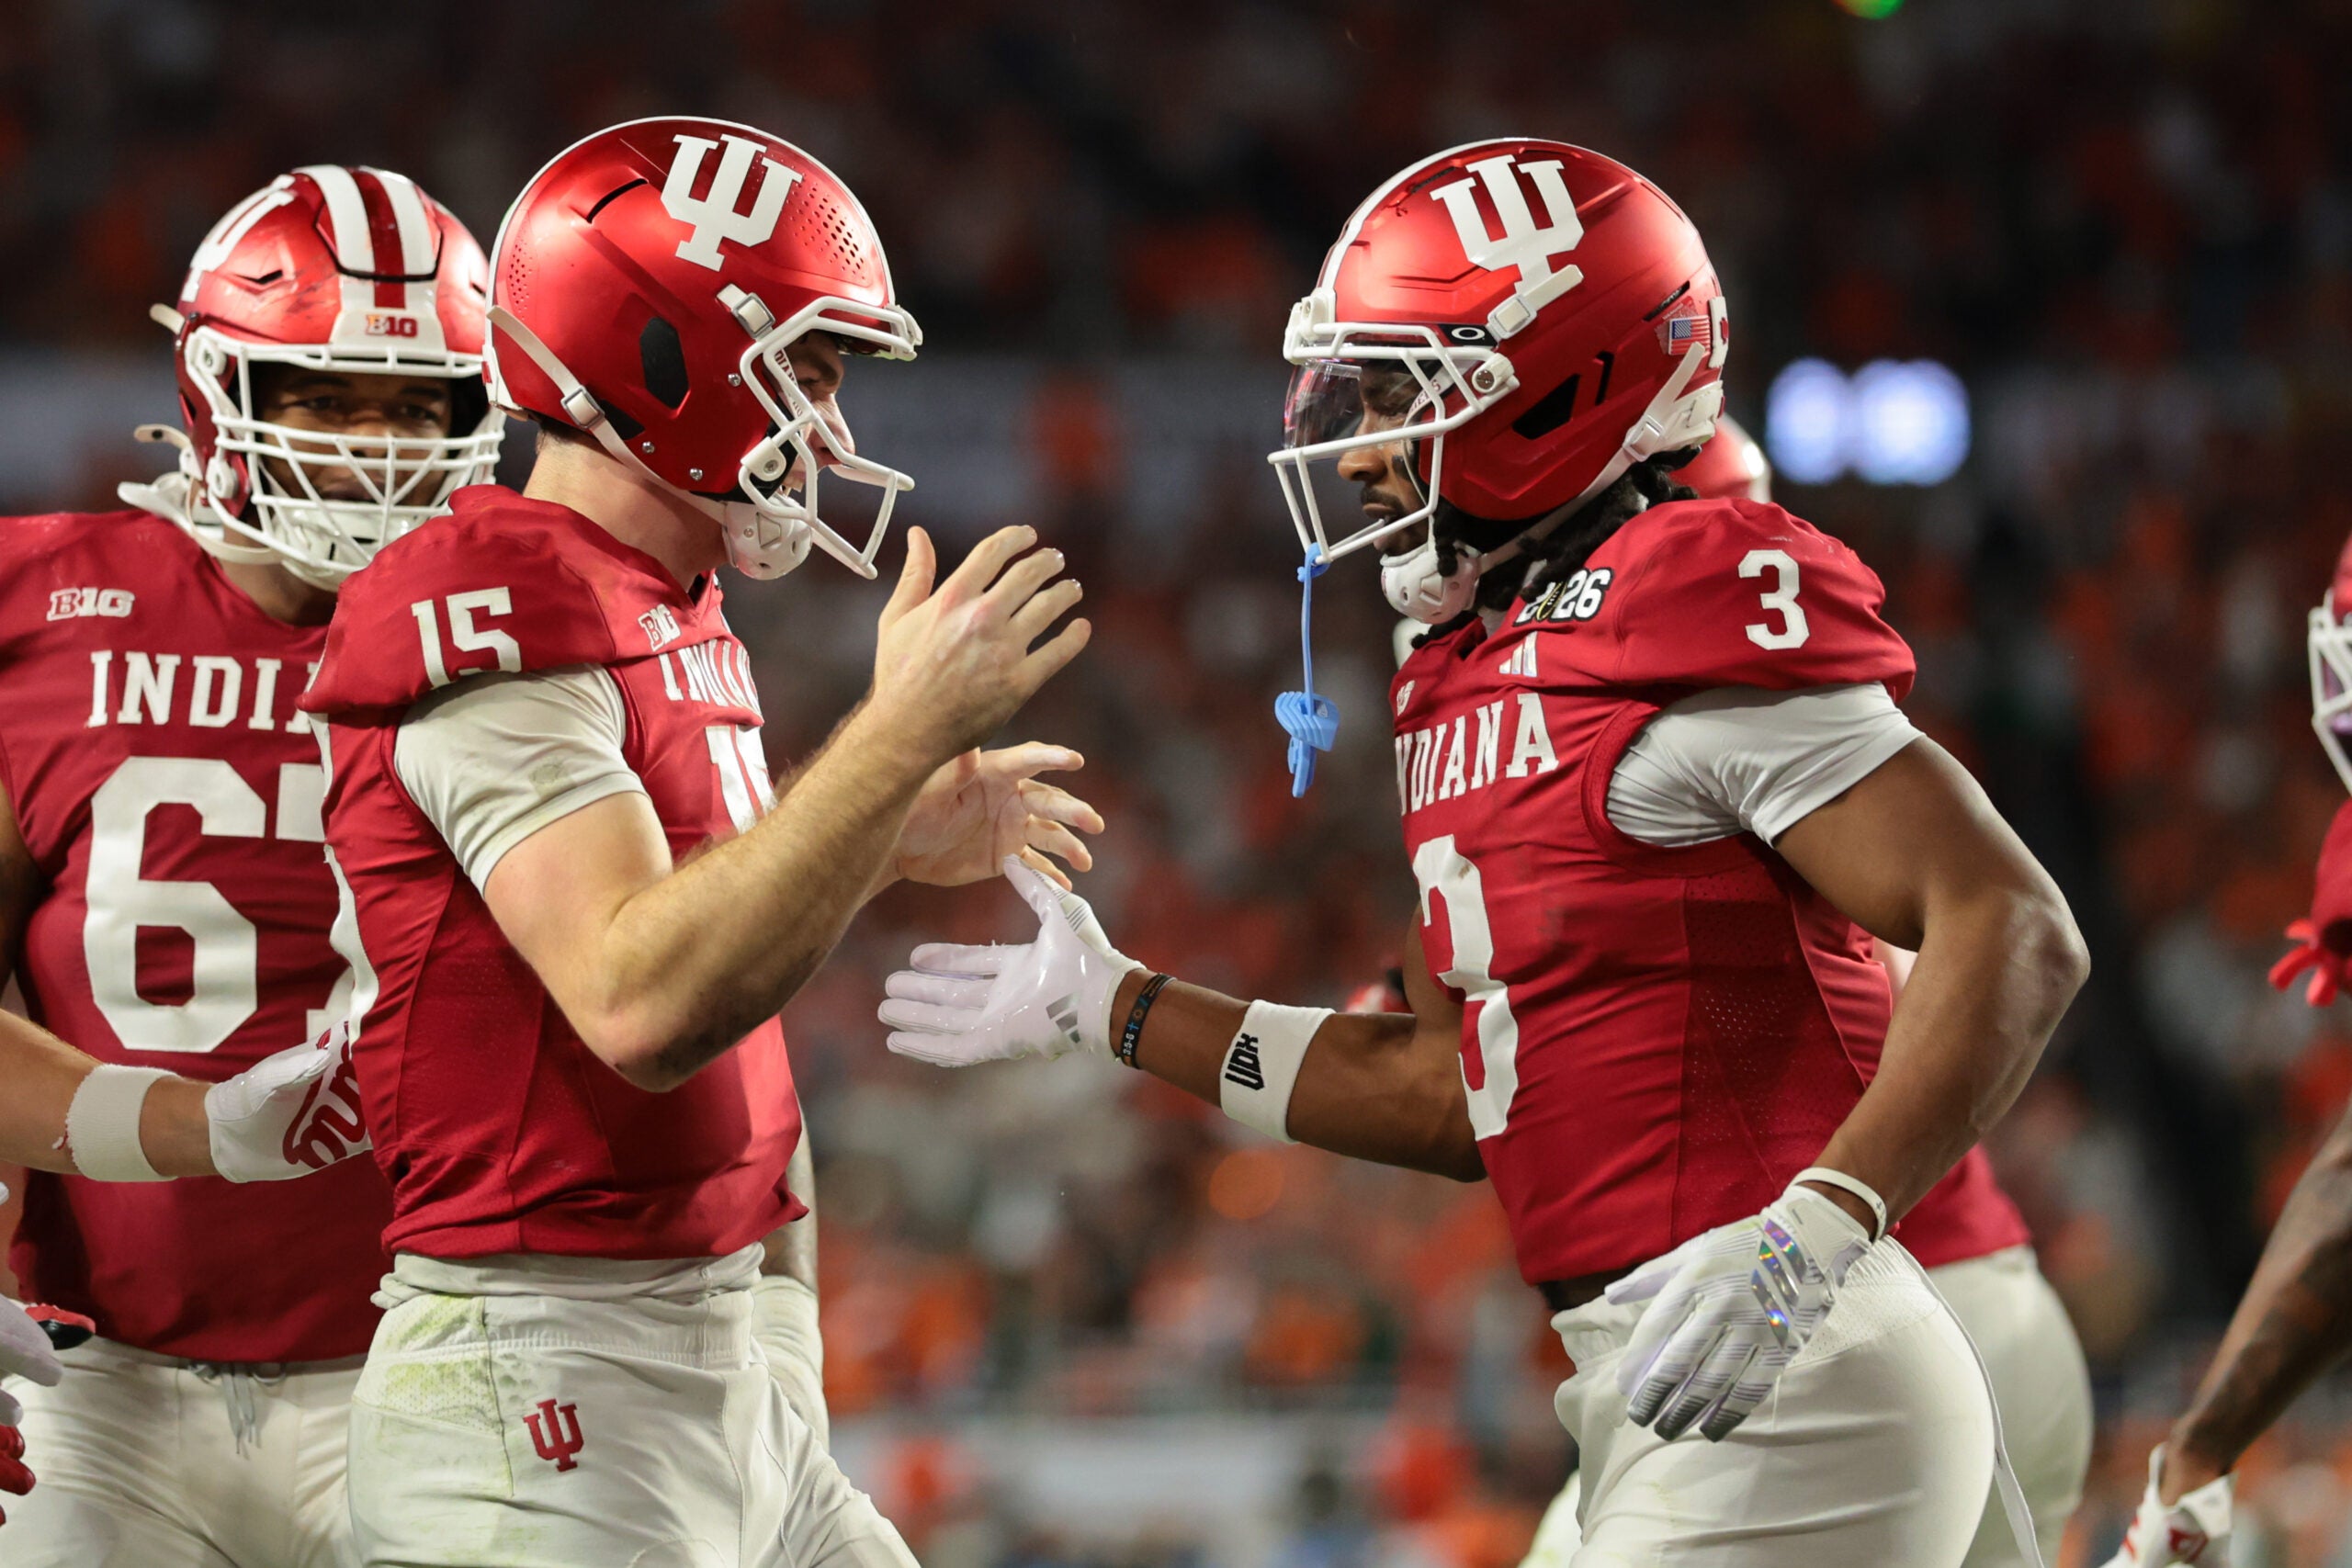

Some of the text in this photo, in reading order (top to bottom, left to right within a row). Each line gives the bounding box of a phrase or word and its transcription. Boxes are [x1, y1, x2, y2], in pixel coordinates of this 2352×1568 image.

[412, 587, 522, 689] 15
[1738, 549, 1810, 650] 3
[1396, 693, 1559, 816] NDIANA
[1413, 834, 1519, 1137] 3
[1225, 1032, 1264, 1090] UDX
